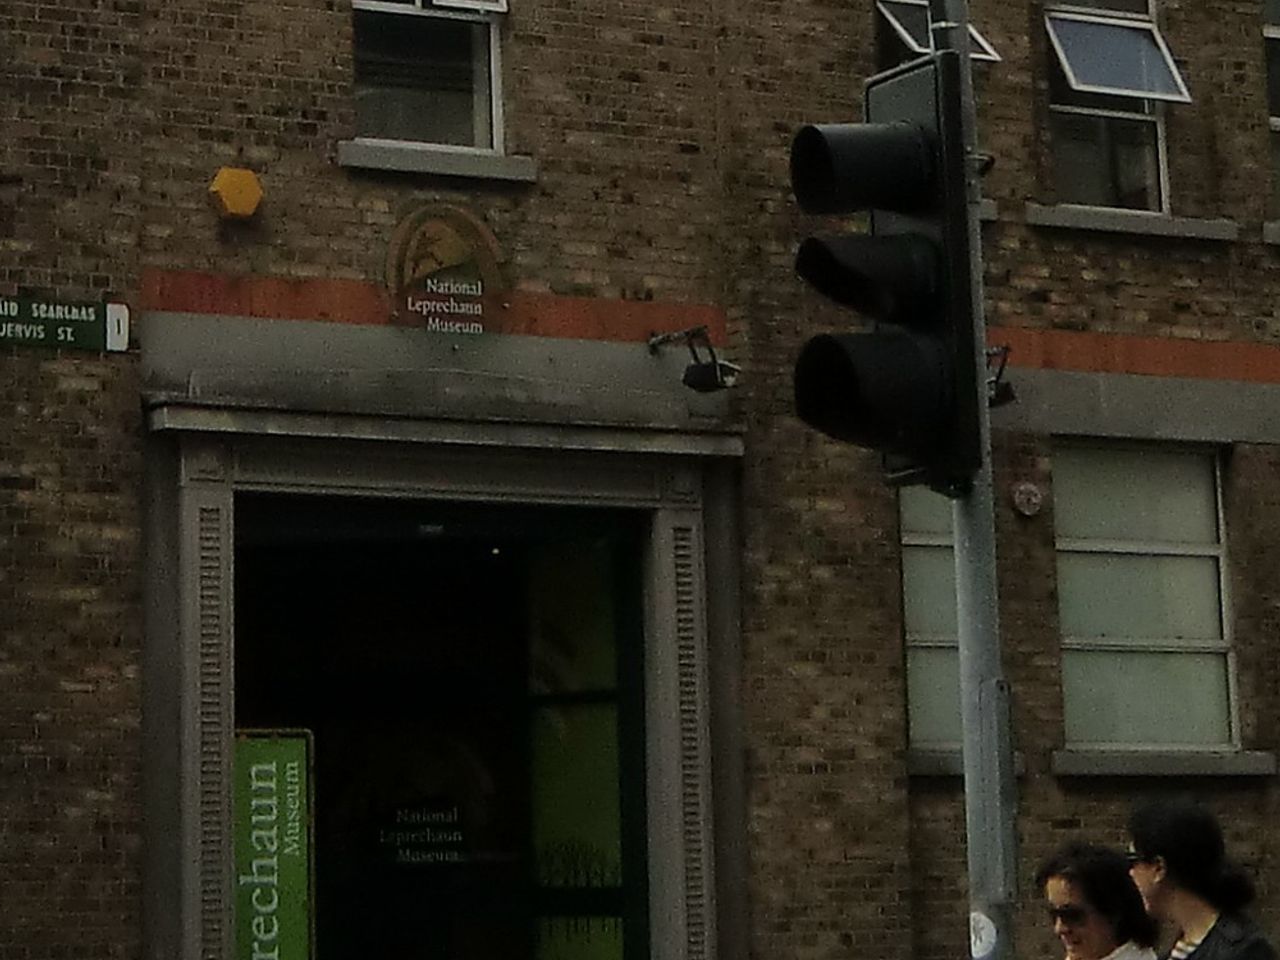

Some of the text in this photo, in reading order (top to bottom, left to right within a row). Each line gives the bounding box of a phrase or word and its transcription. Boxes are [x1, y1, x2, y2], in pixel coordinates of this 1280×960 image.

[426, 278, 482, 296] National
[407, 297, 482, 315] Leprechaun
[0, 323, 45, 339] JERVIS
[427, 317, 483, 334] Museum
[283, 761, 300, 857] Museum
